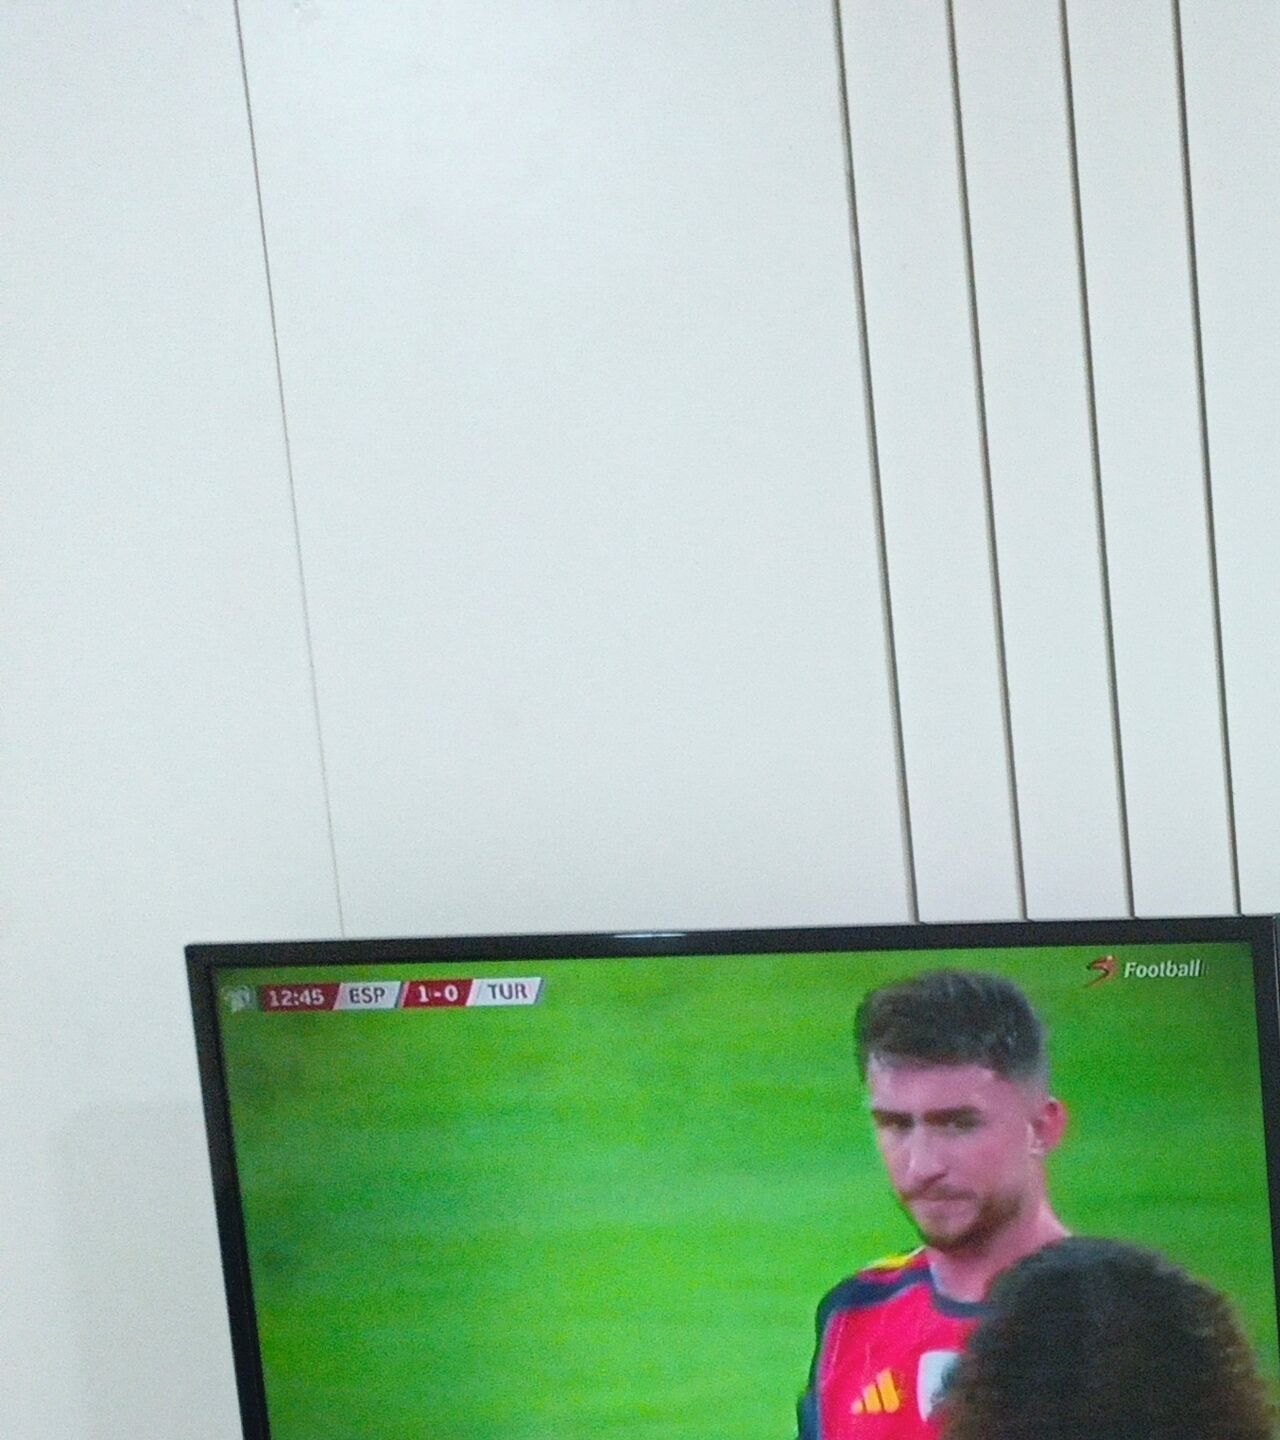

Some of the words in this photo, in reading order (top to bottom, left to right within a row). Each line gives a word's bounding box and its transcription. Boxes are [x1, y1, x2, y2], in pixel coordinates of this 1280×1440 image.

[1123, 958, 1201, 978] Football
[268, 988, 325, 1008] 12:45
[348, 987, 386, 1004] ESP
[418, 984, 459, 1003] 1-0
[487, 983, 528, 1000] TUR
